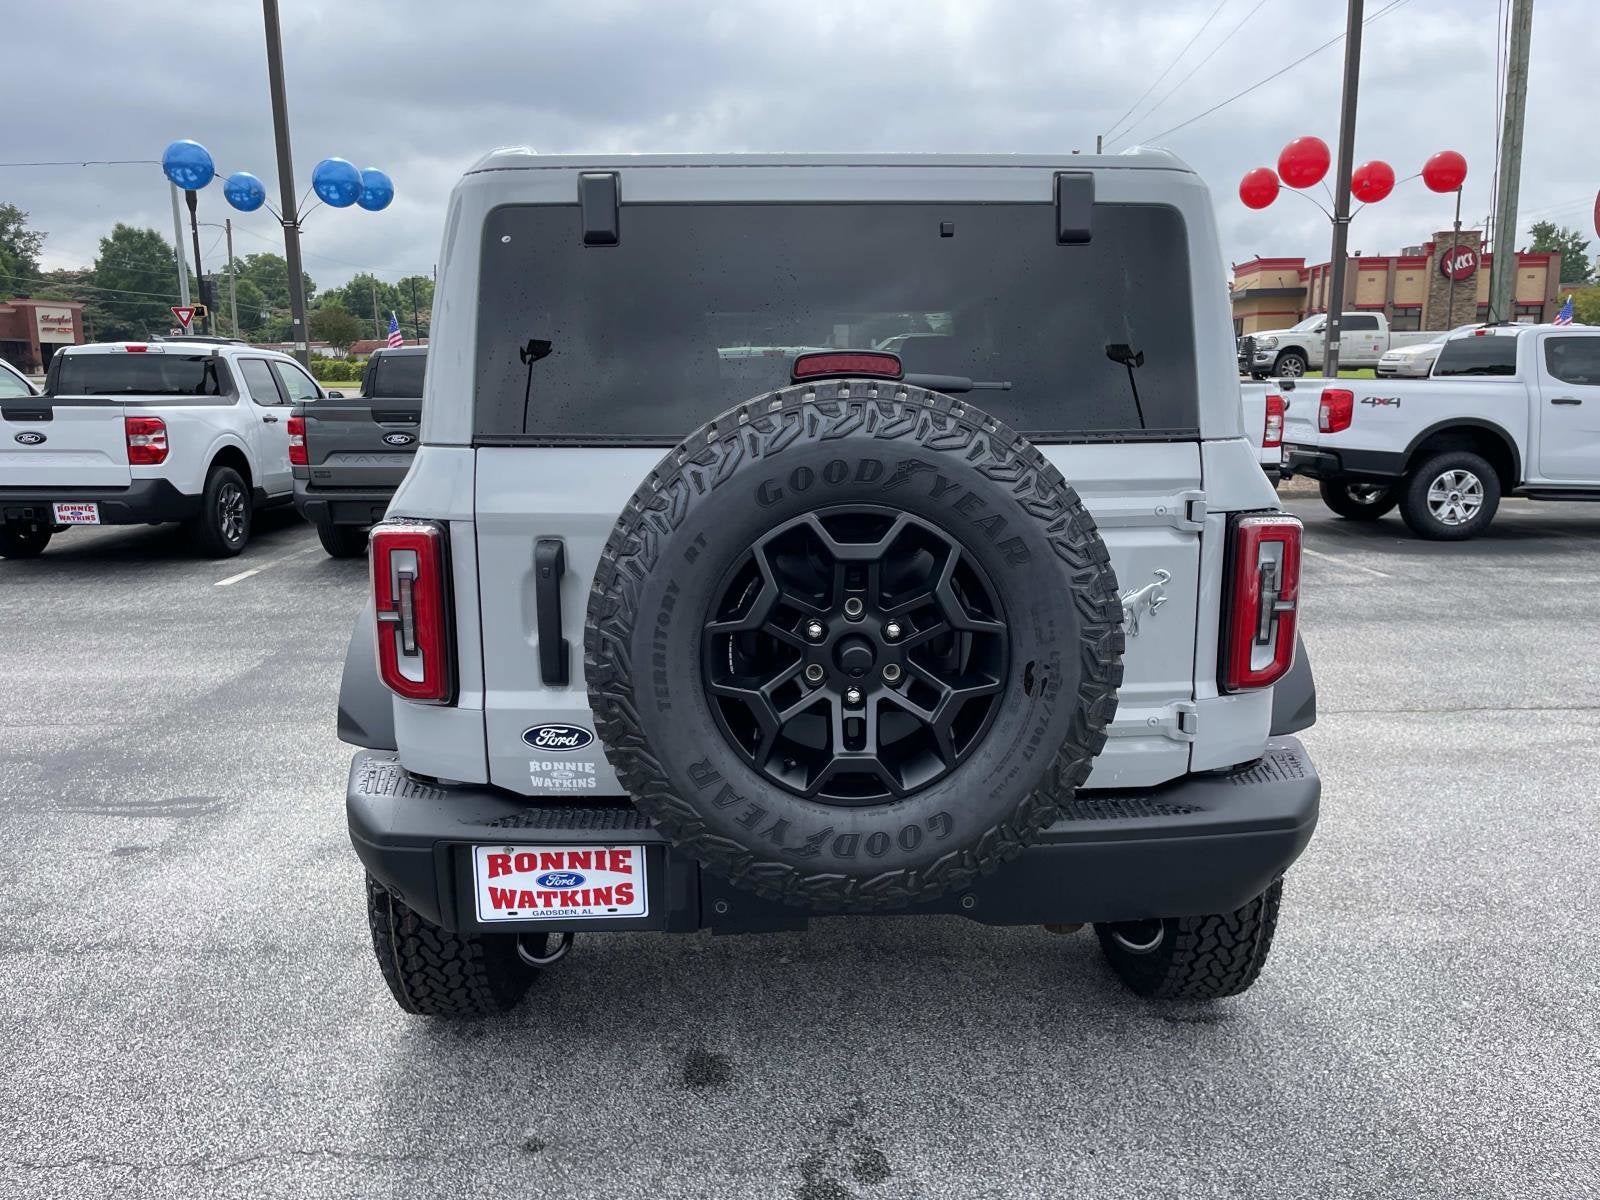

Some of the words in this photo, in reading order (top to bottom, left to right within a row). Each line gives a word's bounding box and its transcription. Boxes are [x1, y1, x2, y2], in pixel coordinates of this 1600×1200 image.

[335, 455, 414, 464] MAVE
[57, 504, 95, 513] RONNIE
[58, 514, 96, 522] WATKINS
[652, 578, 681, 713] TERRITORY
[683, 532, 708, 565] RT
[535, 728, 579, 747] Ford
[529, 760, 595, 774] RONNIE
[530, 776, 597, 788] WATKINS
[487, 850, 633, 879] RONNIE
[545, 872, 576, 886] Ford
[488, 882, 635, 909] WATKINS
[532, 909, 580, 917] GADSDEN,
